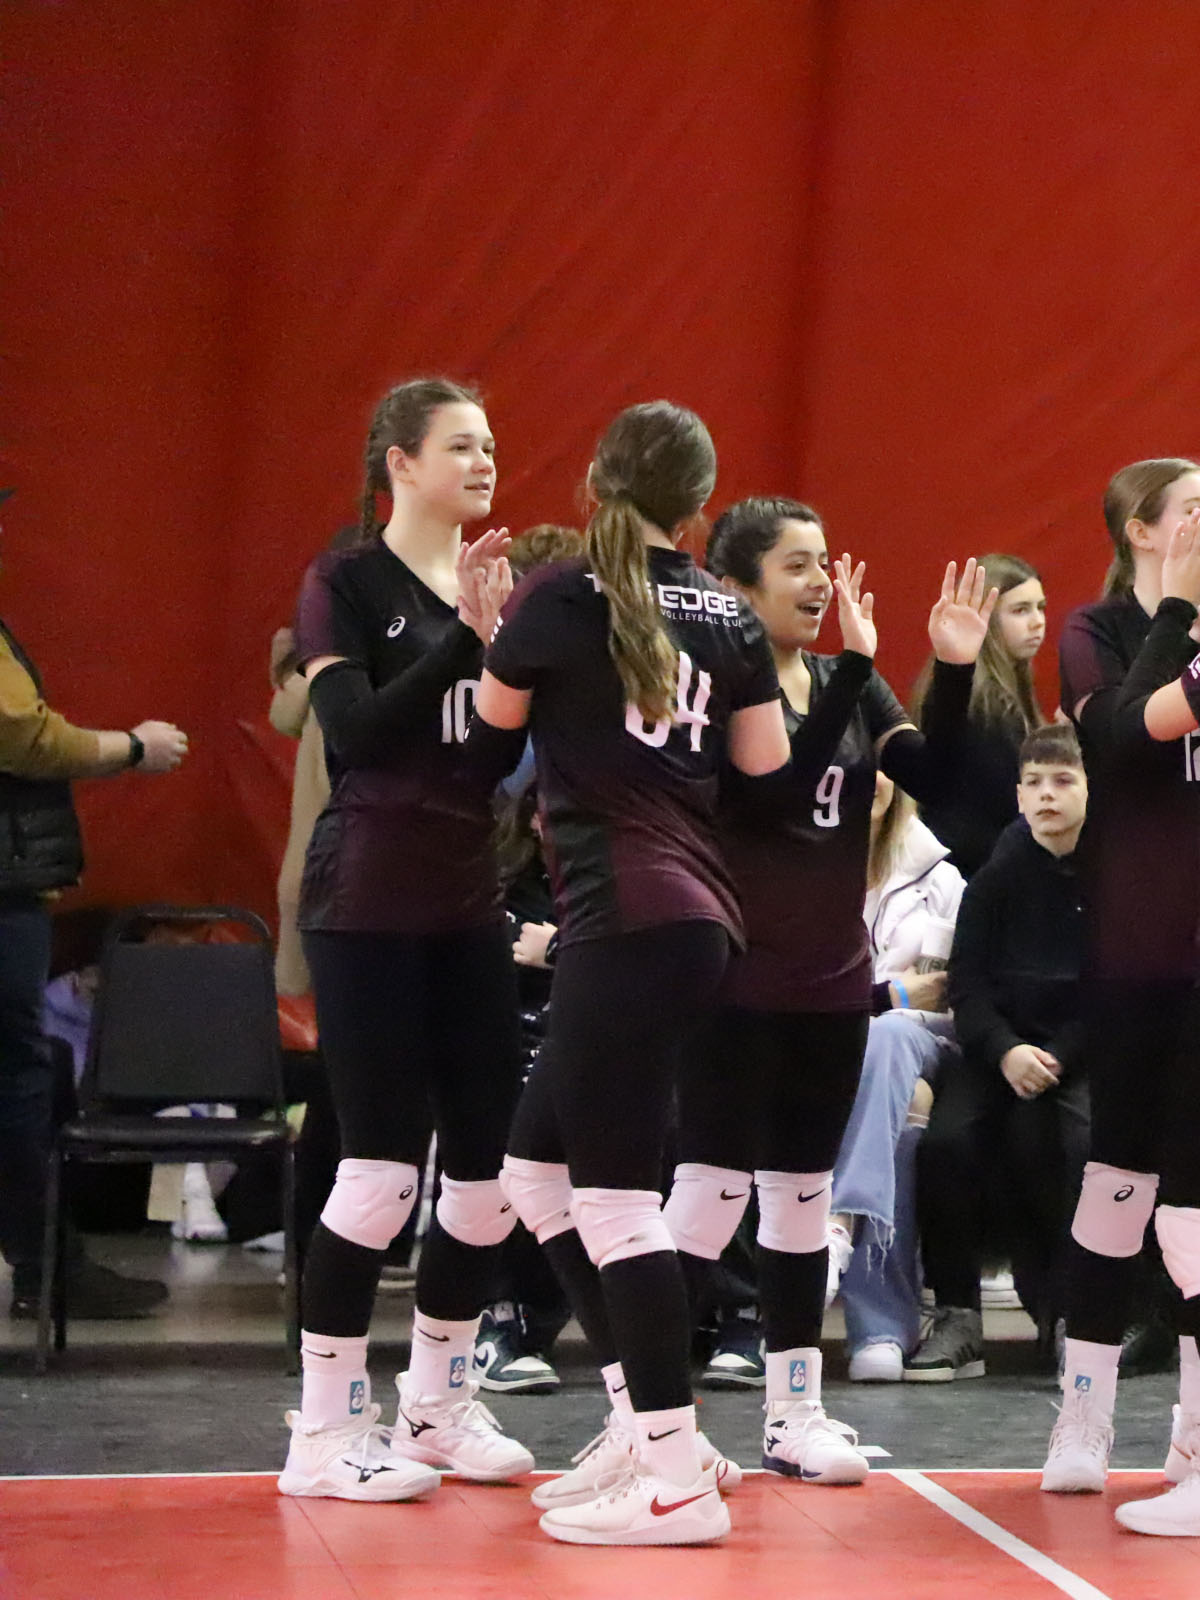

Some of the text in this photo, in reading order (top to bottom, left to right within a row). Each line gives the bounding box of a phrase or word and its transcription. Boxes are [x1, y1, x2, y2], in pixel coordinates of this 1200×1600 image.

[657, 584, 739, 617] EDGE
[660, 608, 719, 625] VOLLEYBALL
[813, 766, 844, 827] 9
